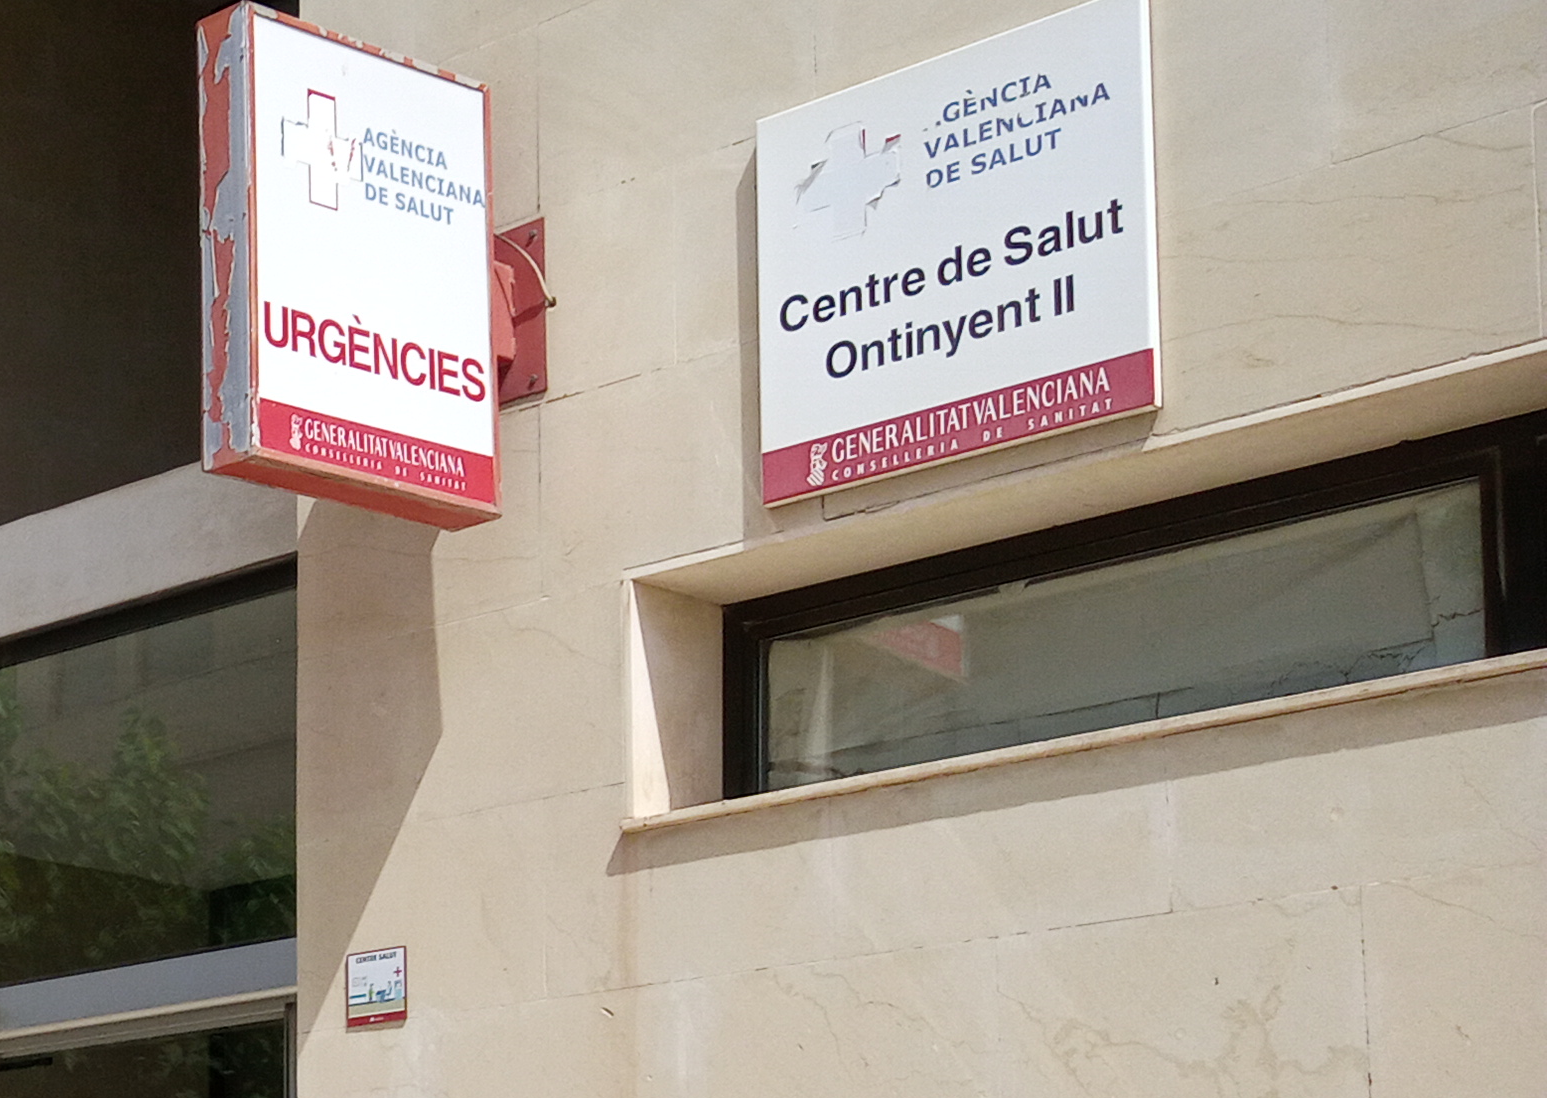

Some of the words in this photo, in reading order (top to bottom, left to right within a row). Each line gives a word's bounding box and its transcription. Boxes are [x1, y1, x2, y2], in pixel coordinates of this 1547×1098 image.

[922, 73, 1052, 132] GÈNCIA
[362, 128, 448, 170] AGÈNCIA
[926, 162, 960, 189] DE
[971, 128, 1062, 178] SALUT
[364, 154, 486, 209] VALENCIANA
[365, 183, 389, 206] DE
[394, 192, 454, 225] SALUT
[779, 267, 926, 332] Centre
[937, 245, 992, 287] de
[1003, 199, 1124, 266] Salut
[263, 301, 486, 402] URGÈNCIES
[825, 287, 1041, 379] Ontinyent
[1053, 275, 1075, 316] II
[305, 443, 383, 471] CONSELLERIA
[395, 466, 408, 478] DE
[420, 471, 467, 491] SANITAT
[832, 440, 960, 481] CONSELLERIA
[983, 428, 1004, 443] DE
[1028, 397, 1114, 431] SANITAT
